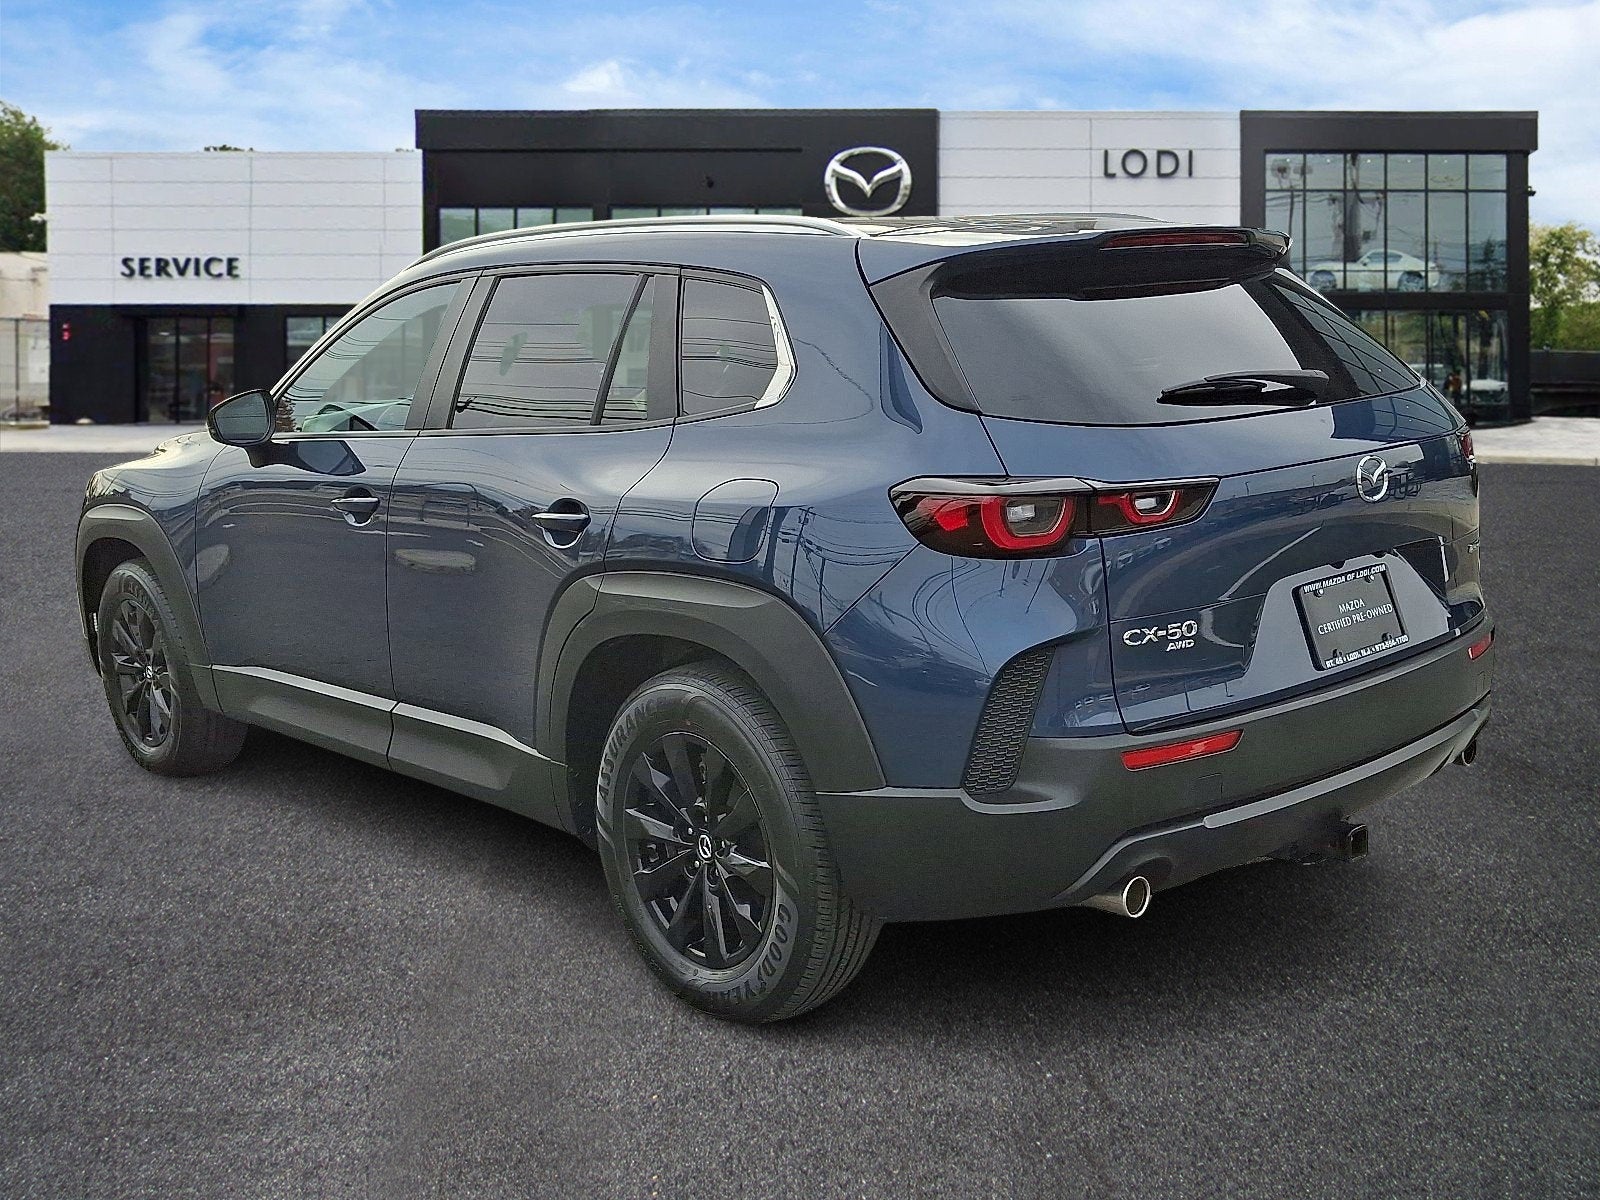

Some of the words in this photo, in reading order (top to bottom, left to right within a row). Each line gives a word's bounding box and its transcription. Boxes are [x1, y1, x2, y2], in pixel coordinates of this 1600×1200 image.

[1103, 148, 1193, 178] LODI
[120, 256, 240, 279] SERVICE
[1346, 572, 1356, 581] OF
[1338, 598, 1365, 614] MAZDA
[1317, 616, 1352, 635] CERTIFIED
[1352, 603, 1393, 624] PRE-OWNED
[1122, 620, 1198, 646] CX-50
[1165, 639, 1195, 652] AWD
